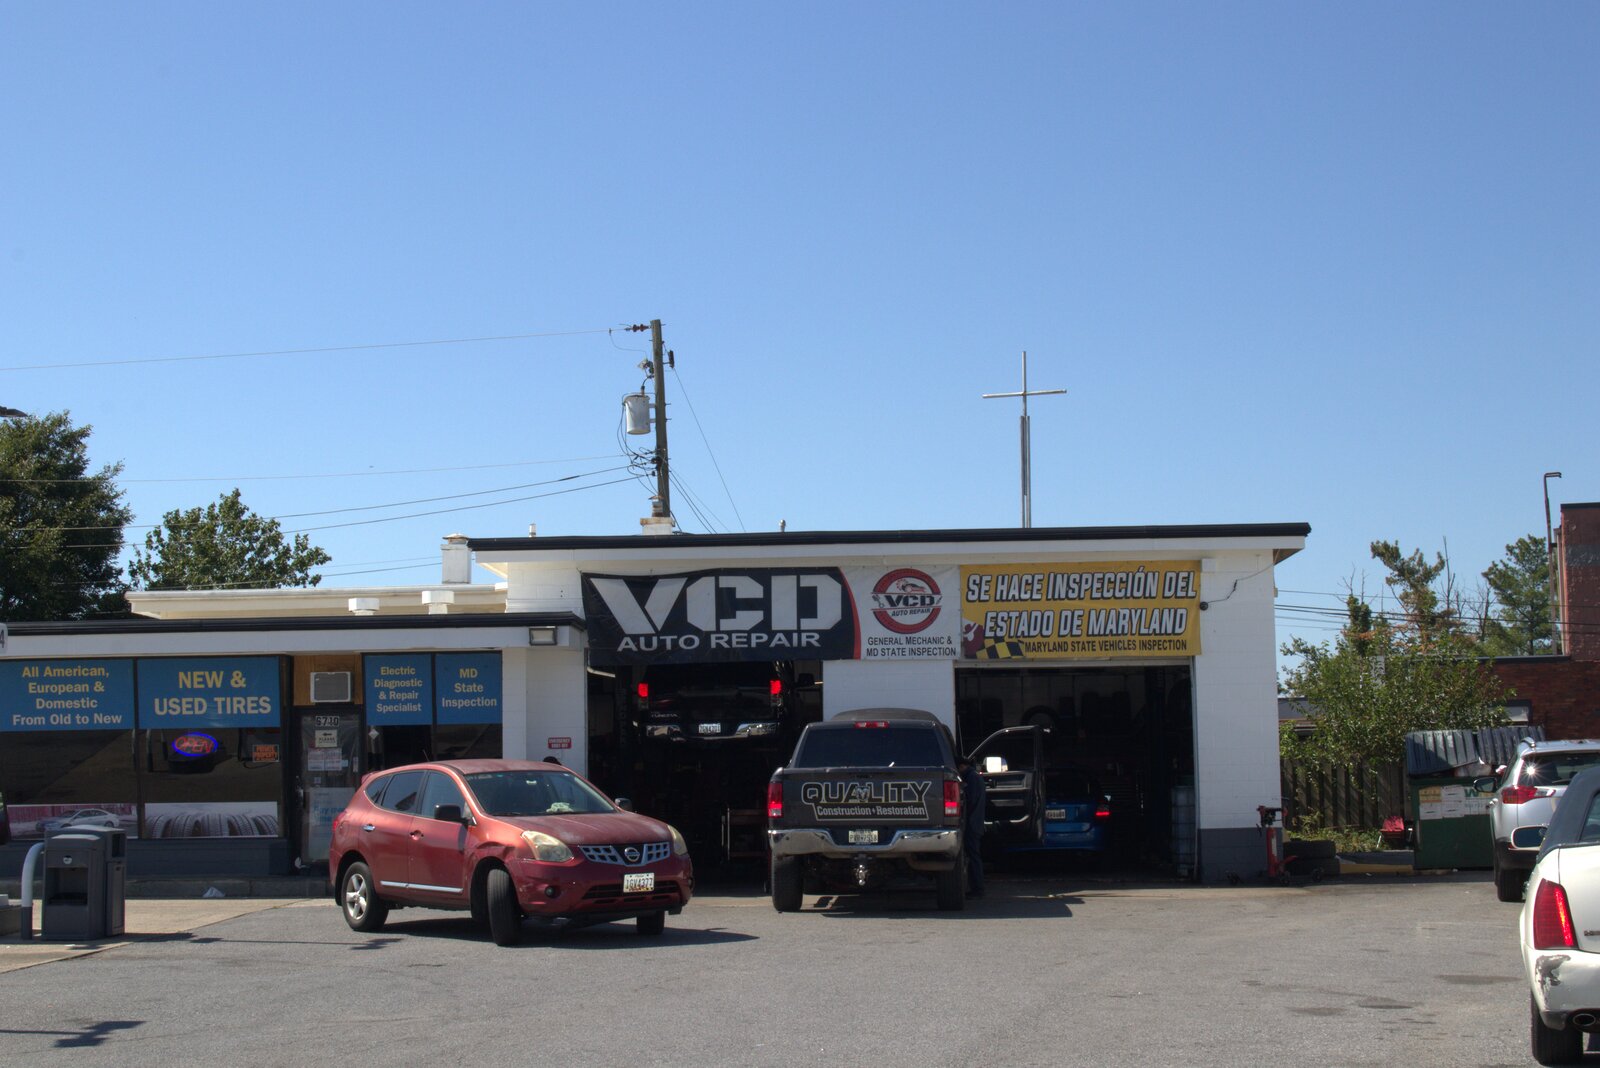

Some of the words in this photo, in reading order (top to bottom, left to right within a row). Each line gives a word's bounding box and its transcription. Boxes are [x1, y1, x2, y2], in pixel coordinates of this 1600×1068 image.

[966, 574, 991, 601] SE
[996, 573, 1043, 600] HACE
[1047, 566, 1159, 600] INSPECCIÓN
[1163, 571, 1196, 598] DEL
[589, 574, 842, 635] VCD
[884, 595, 935, 607] VCD
[892, 609, 908, 617] AUTO
[909, 608, 931, 616] REPAIR
[984, 611, 1055, 638] ESTADO
[1062, 610, 1083, 636] DE
[1087, 608, 1188, 636] MARYLAND
[617, 634, 700, 652] AUTO
[710, 632, 822, 649] REPAIR
[867, 636, 903, 645] GENERAL
[905, 636, 944, 645] MECHANIC
[946, 636, 953, 645] &
[1024, 641, 1069, 652] MARYLAND
[1071, 641, 1097, 651] STATE
[1098, 640, 1137, 651] VEHICLES
[1138, 639, 1187, 650] INSPECTION
[866, 648, 878, 657] MD
[880, 647, 906, 657] STATE
[908, 647, 956, 656] INSPECTION
[22, 666, 39, 678] All
[44, 666, 110, 678] American,
[380, 666, 416, 676] Electric
[459, 668, 478, 678] MD
[178, 671, 224, 689] NEW
[230, 670, 247, 688] &
[374, 678, 423, 689] Diagnostic
[28, 682, 89, 697] European
[93, 681, 105, 693] &
[454, 683, 484, 693] State
[379, 691, 387, 700] &
[389, 690, 419, 702] Repair
[36, 698, 98, 709] Domestic
[154, 697, 207, 716] USED
[213, 696, 272, 714] TIRES
[376, 702, 422, 714] Specialist
[442, 697, 497, 709] Inspection
[12, 714, 46, 726] From
[50, 714, 71, 725] Old
[76, 714, 89, 725] to
[93, 713, 122, 724] New
[175, 736, 215, 753] OPEN
[801, 781, 932, 804] QUALITY
[817, 805, 873, 816] Construction
[875, 805, 926, 816] Restoration
